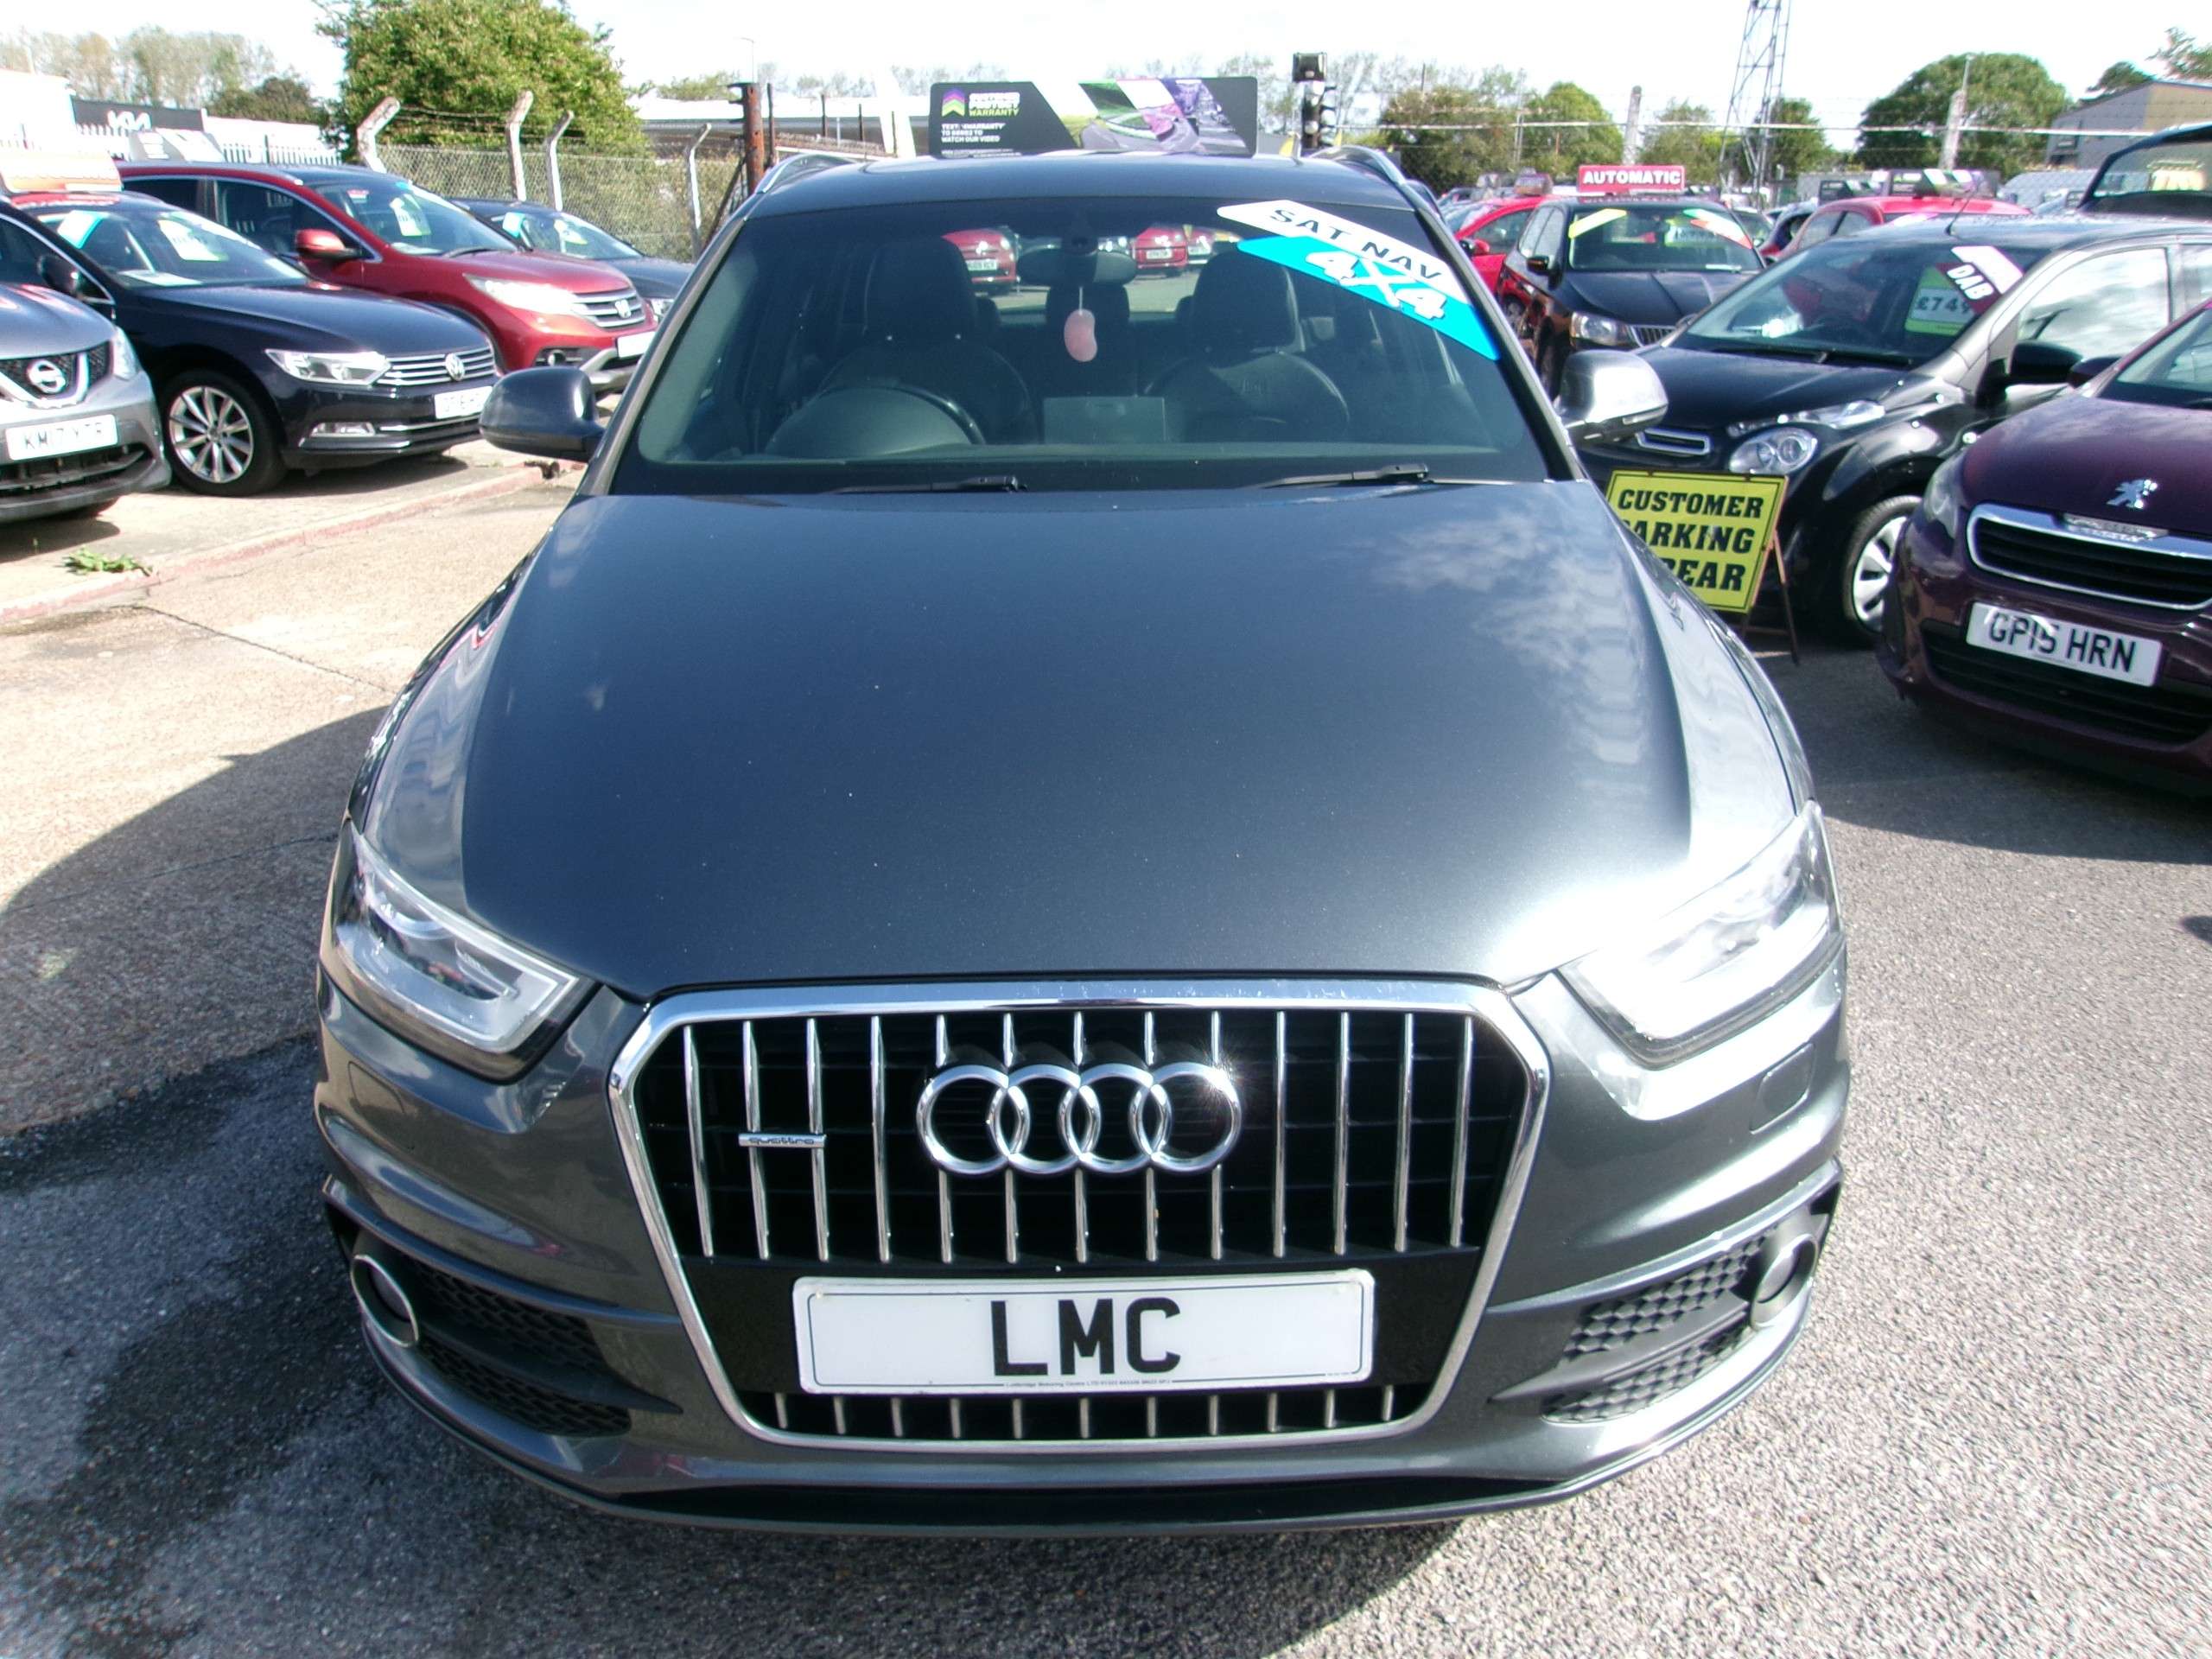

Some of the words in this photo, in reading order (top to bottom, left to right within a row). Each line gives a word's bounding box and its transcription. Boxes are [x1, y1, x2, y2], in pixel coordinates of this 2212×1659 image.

[1582, 169, 1681, 185] AUTOMATIC
[1269, 209, 1354, 241] SAT
[1361, 241, 1441, 280] NAV
[1946, 264, 1994, 300] DAB
[1618, 489, 1764, 518] CUSTOMER
[1623, 519, 1755, 554] ARKING
[1989, 611, 2059, 654] GP15
[2066, 628, 2136, 673] HRN
[989, 1296, 1182, 1377] LMC
